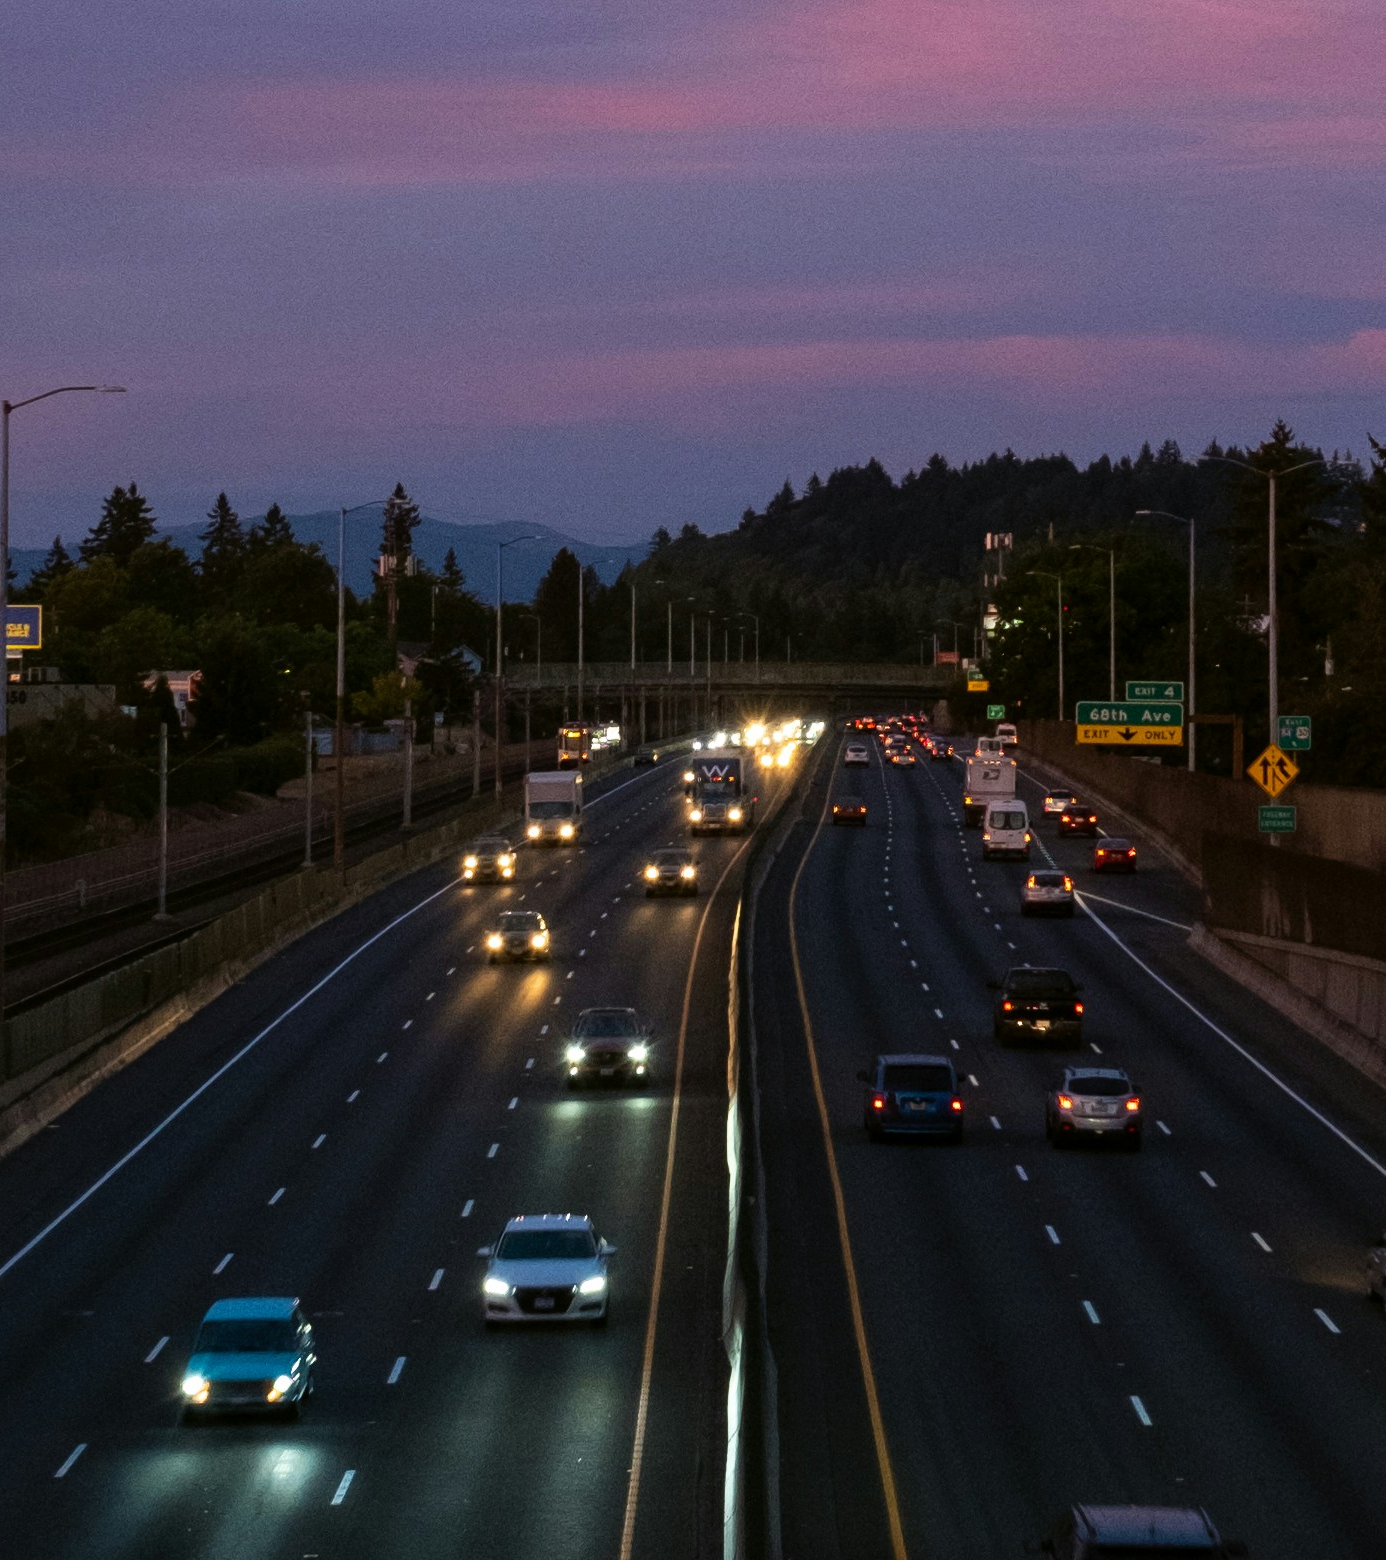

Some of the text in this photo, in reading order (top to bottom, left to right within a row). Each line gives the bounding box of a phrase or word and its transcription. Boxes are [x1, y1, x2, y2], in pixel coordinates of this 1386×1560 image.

[1134, 686, 1175, 697] EXIT 4
[1090, 708, 1171, 722] 68th Ave
[1083, 729, 1176, 740] EXIT ONLY
